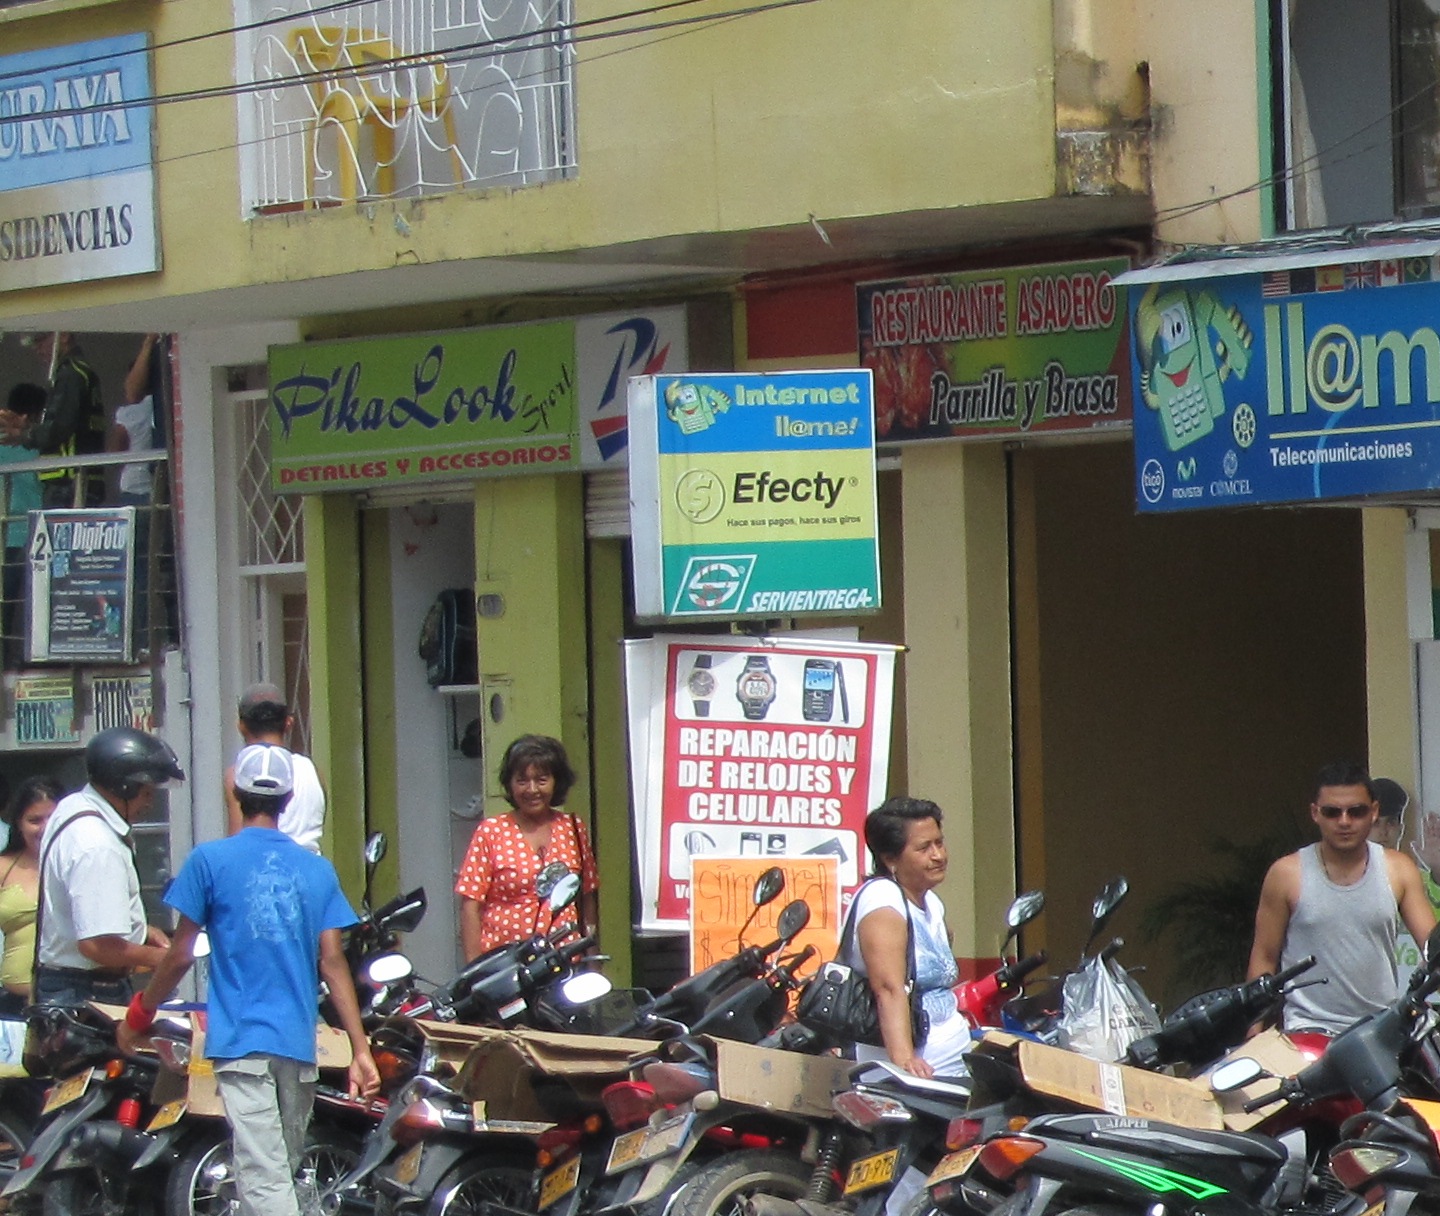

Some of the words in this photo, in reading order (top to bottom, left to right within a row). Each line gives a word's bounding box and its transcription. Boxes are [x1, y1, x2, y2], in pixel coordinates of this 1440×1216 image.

[871, 278, 1007, 348] RESTAURANTE
[1016, 270, 1117, 336] ASADERO
[735, 383, 860, 407] Internet
[929, 366, 1017, 427] Parrilla
[1018, 387, 1043, 432] y
[1044, 360, 1119, 417] Brasa
[776, 415, 860, 438] ll@me!
[280, 460, 388, 485] DETALLES
[396, 458, 411, 477] Y
[421, 444, 572, 473] ACCESORIOS
[1269, 439, 1413, 467] Telecomunicaciones
[733, 471, 846, 509] Efecty
[726, 517, 748, 528] Hace
[750, 519, 765, 528] sus
[799, 517, 819, 527] hace
[822, 518, 838, 527] sus
[840, 516, 861, 527] giros
[36, 532, 47, 561] 2
[746, 588, 873, 613] SERVIENTREGA
[679, 727, 858, 764] REPARACIÓN
[678, 760, 715, 790] DE
[720, 762, 833, 796] RELOJES
[838, 767, 857, 796] Y
[687, 792, 842, 827] CELULARES
